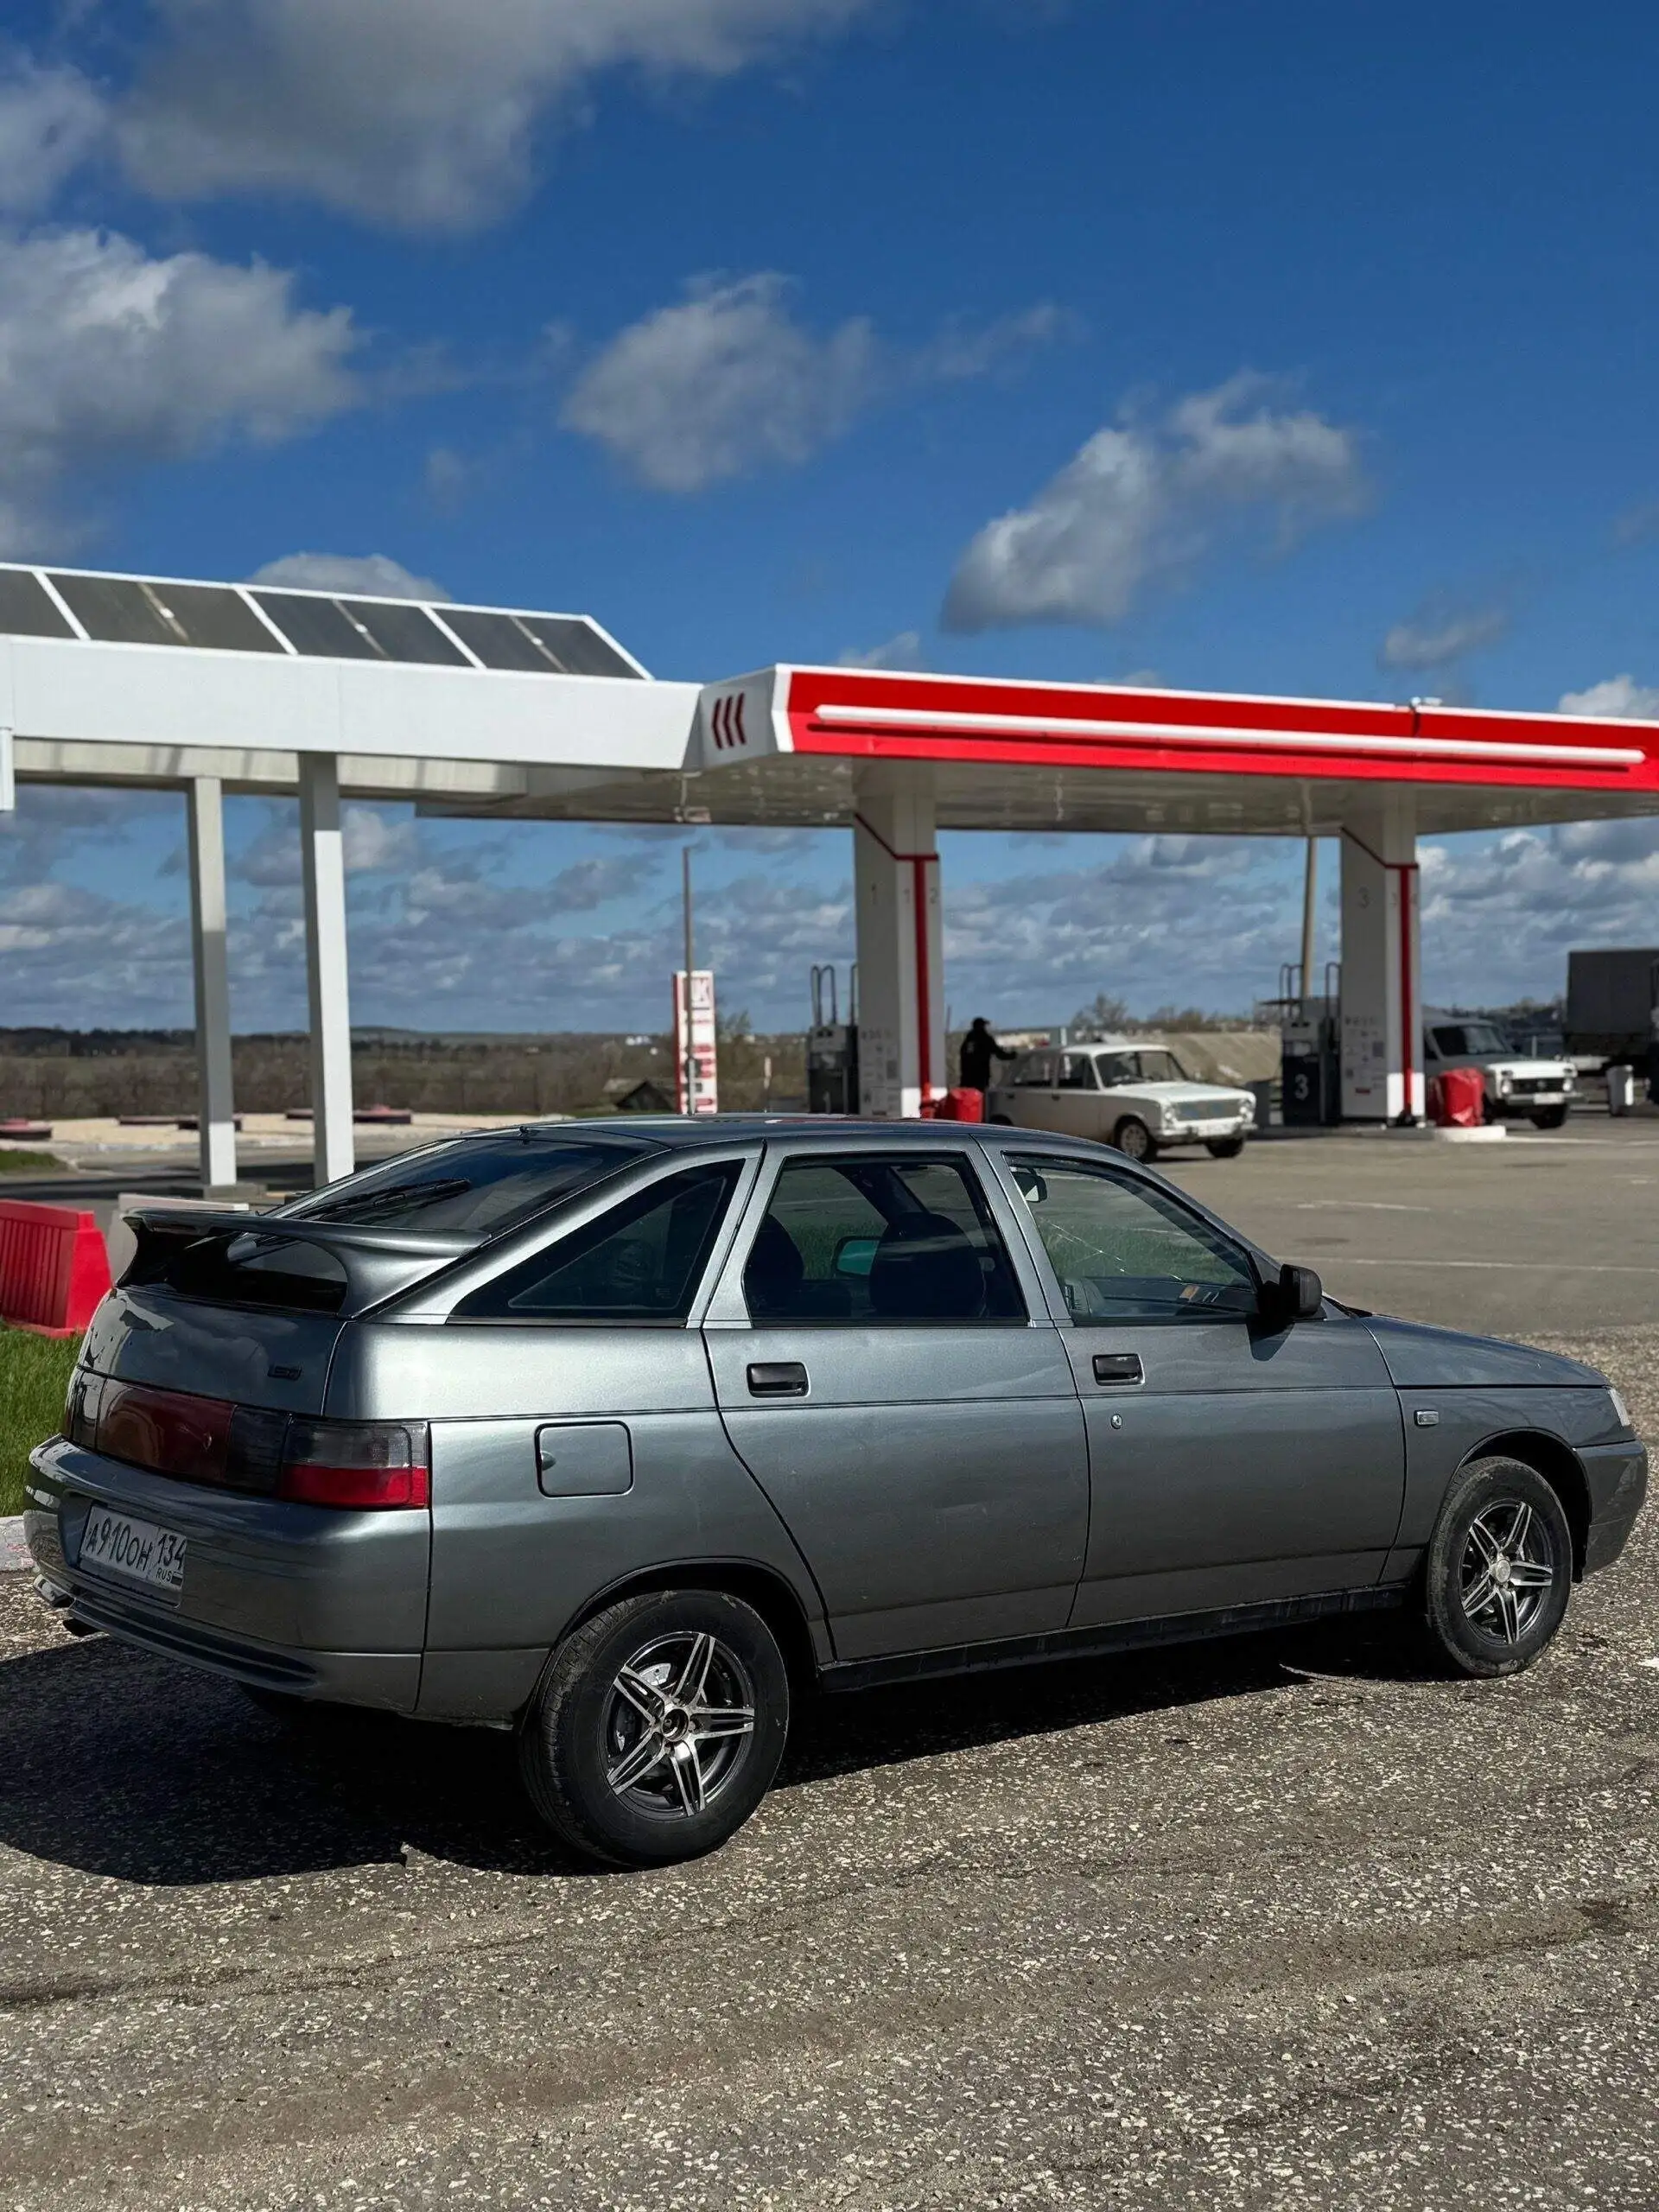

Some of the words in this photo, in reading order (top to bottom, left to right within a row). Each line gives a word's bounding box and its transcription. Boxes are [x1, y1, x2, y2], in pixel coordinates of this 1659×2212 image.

[1357, 885, 1371, 910] 3
[1294, 1073, 1309, 1101] 3
[157, 1533, 186, 1570] 134
[156, 1567, 173, 1582] RUS
